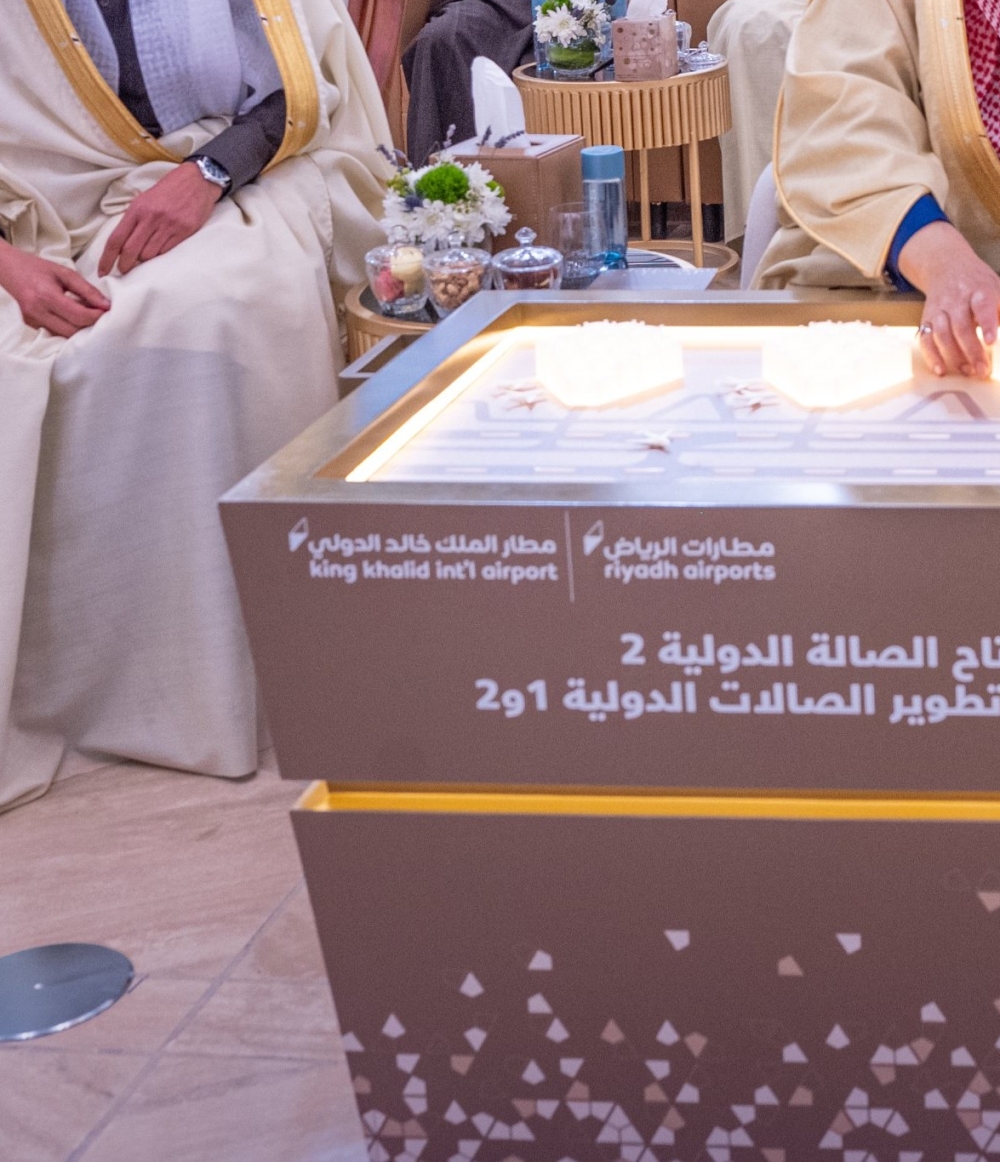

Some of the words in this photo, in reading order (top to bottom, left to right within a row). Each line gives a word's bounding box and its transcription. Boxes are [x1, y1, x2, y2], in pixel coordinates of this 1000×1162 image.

[308, 534, 381, 560] الدولي
[385, 534, 431, 553] خالد
[435, 535, 498, 553] الملك
[502, 535, 557, 558] مطار
[602, 534, 677, 561] الرياض
[682, 537, 775, 561] مطارات
[309, 559, 357, 584] king
[362, 560, 430, 579] khalid
[435, 559, 476, 579] int'l
[481, 561, 558, 585] airport
[604, 559, 679, 584] riyadh
[683, 559, 776, 584] airports
[621, 633, 646, 665] 2
[658, 631, 793, 676] الدولية
[806, 633, 938, 668] الصالة
[563, 678, 697, 722] الدولية
[709, 681, 875, 715] الصالات
